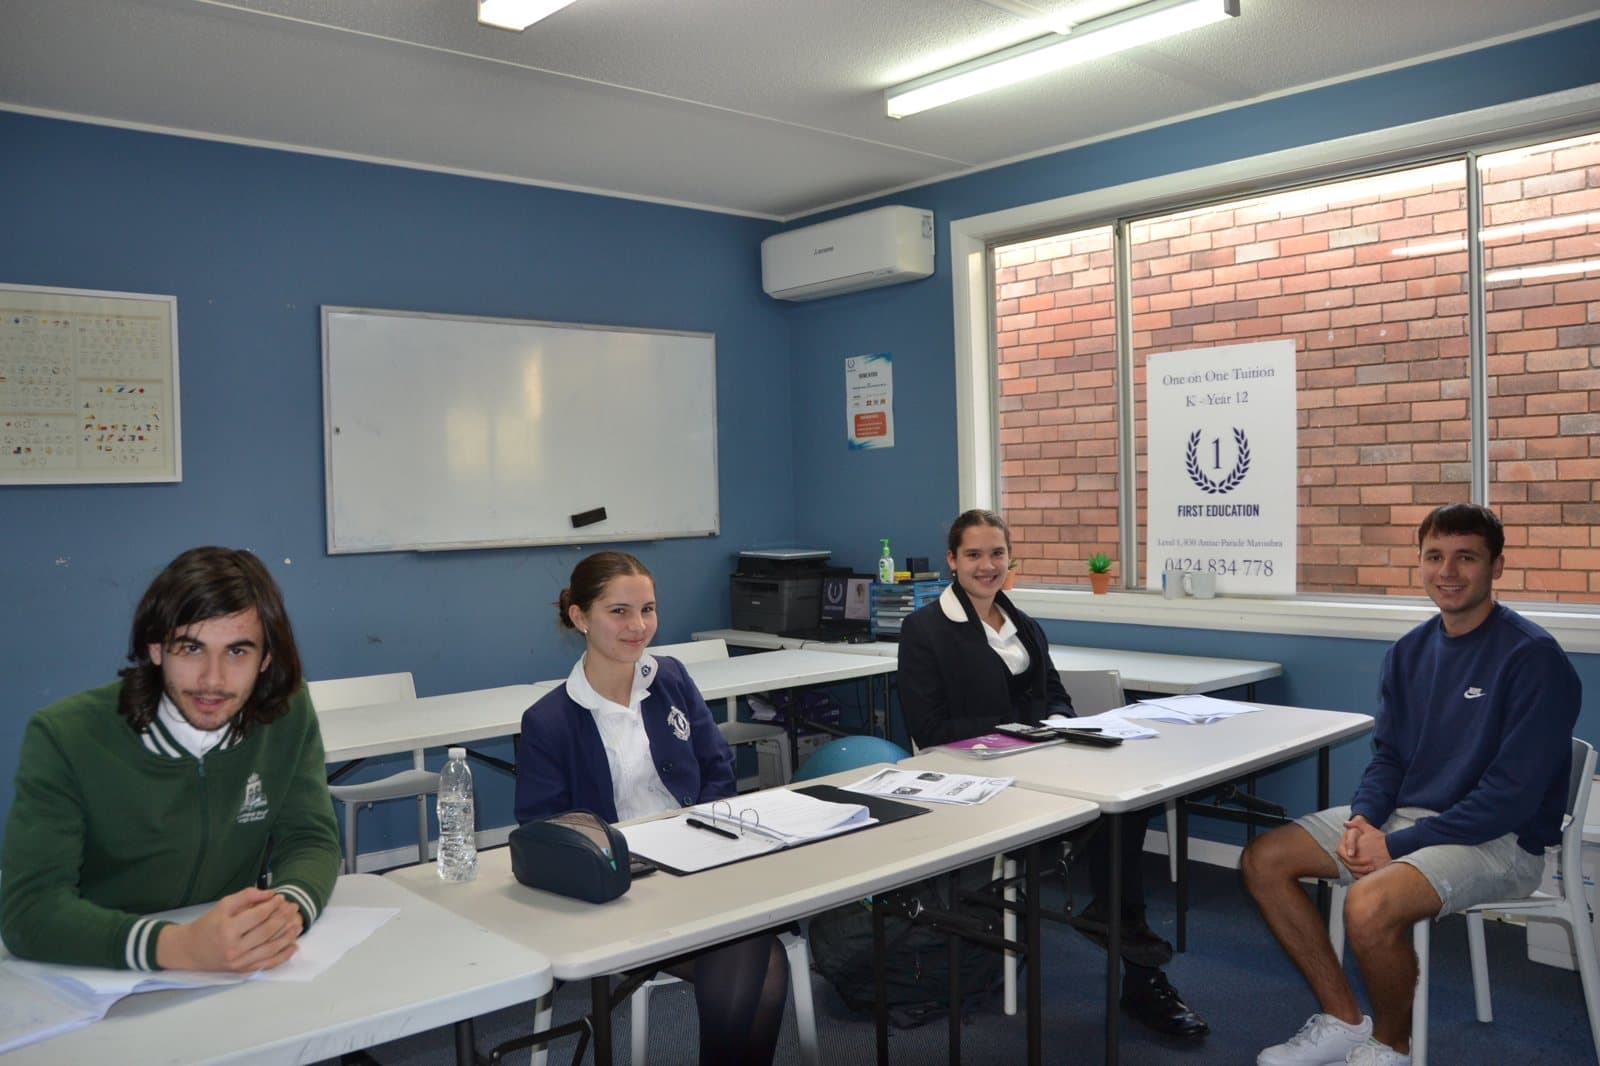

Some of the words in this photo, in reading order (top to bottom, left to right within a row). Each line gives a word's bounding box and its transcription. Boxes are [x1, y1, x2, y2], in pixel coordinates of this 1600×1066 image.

[1162, 374, 1185, 386] One
[1187, 375, 1202, 384] on
[1204, 370, 1229, 383] One
[1232, 366, 1275, 381] Tuition
[1185, 395, 1196, 407] K
[1207, 393, 1232, 406] Year
[1236, 391, 1249, 404] 12
[1211, 437, 1222, 470] 1
[1177, 504, 1204, 518] FIRST
[1206, 504, 1260, 517] EDUCATION
[1164, 557, 1203, 573] 0424
[1207, 558, 1238, 576] 834
[1243, 559, 1274, 577] 778
